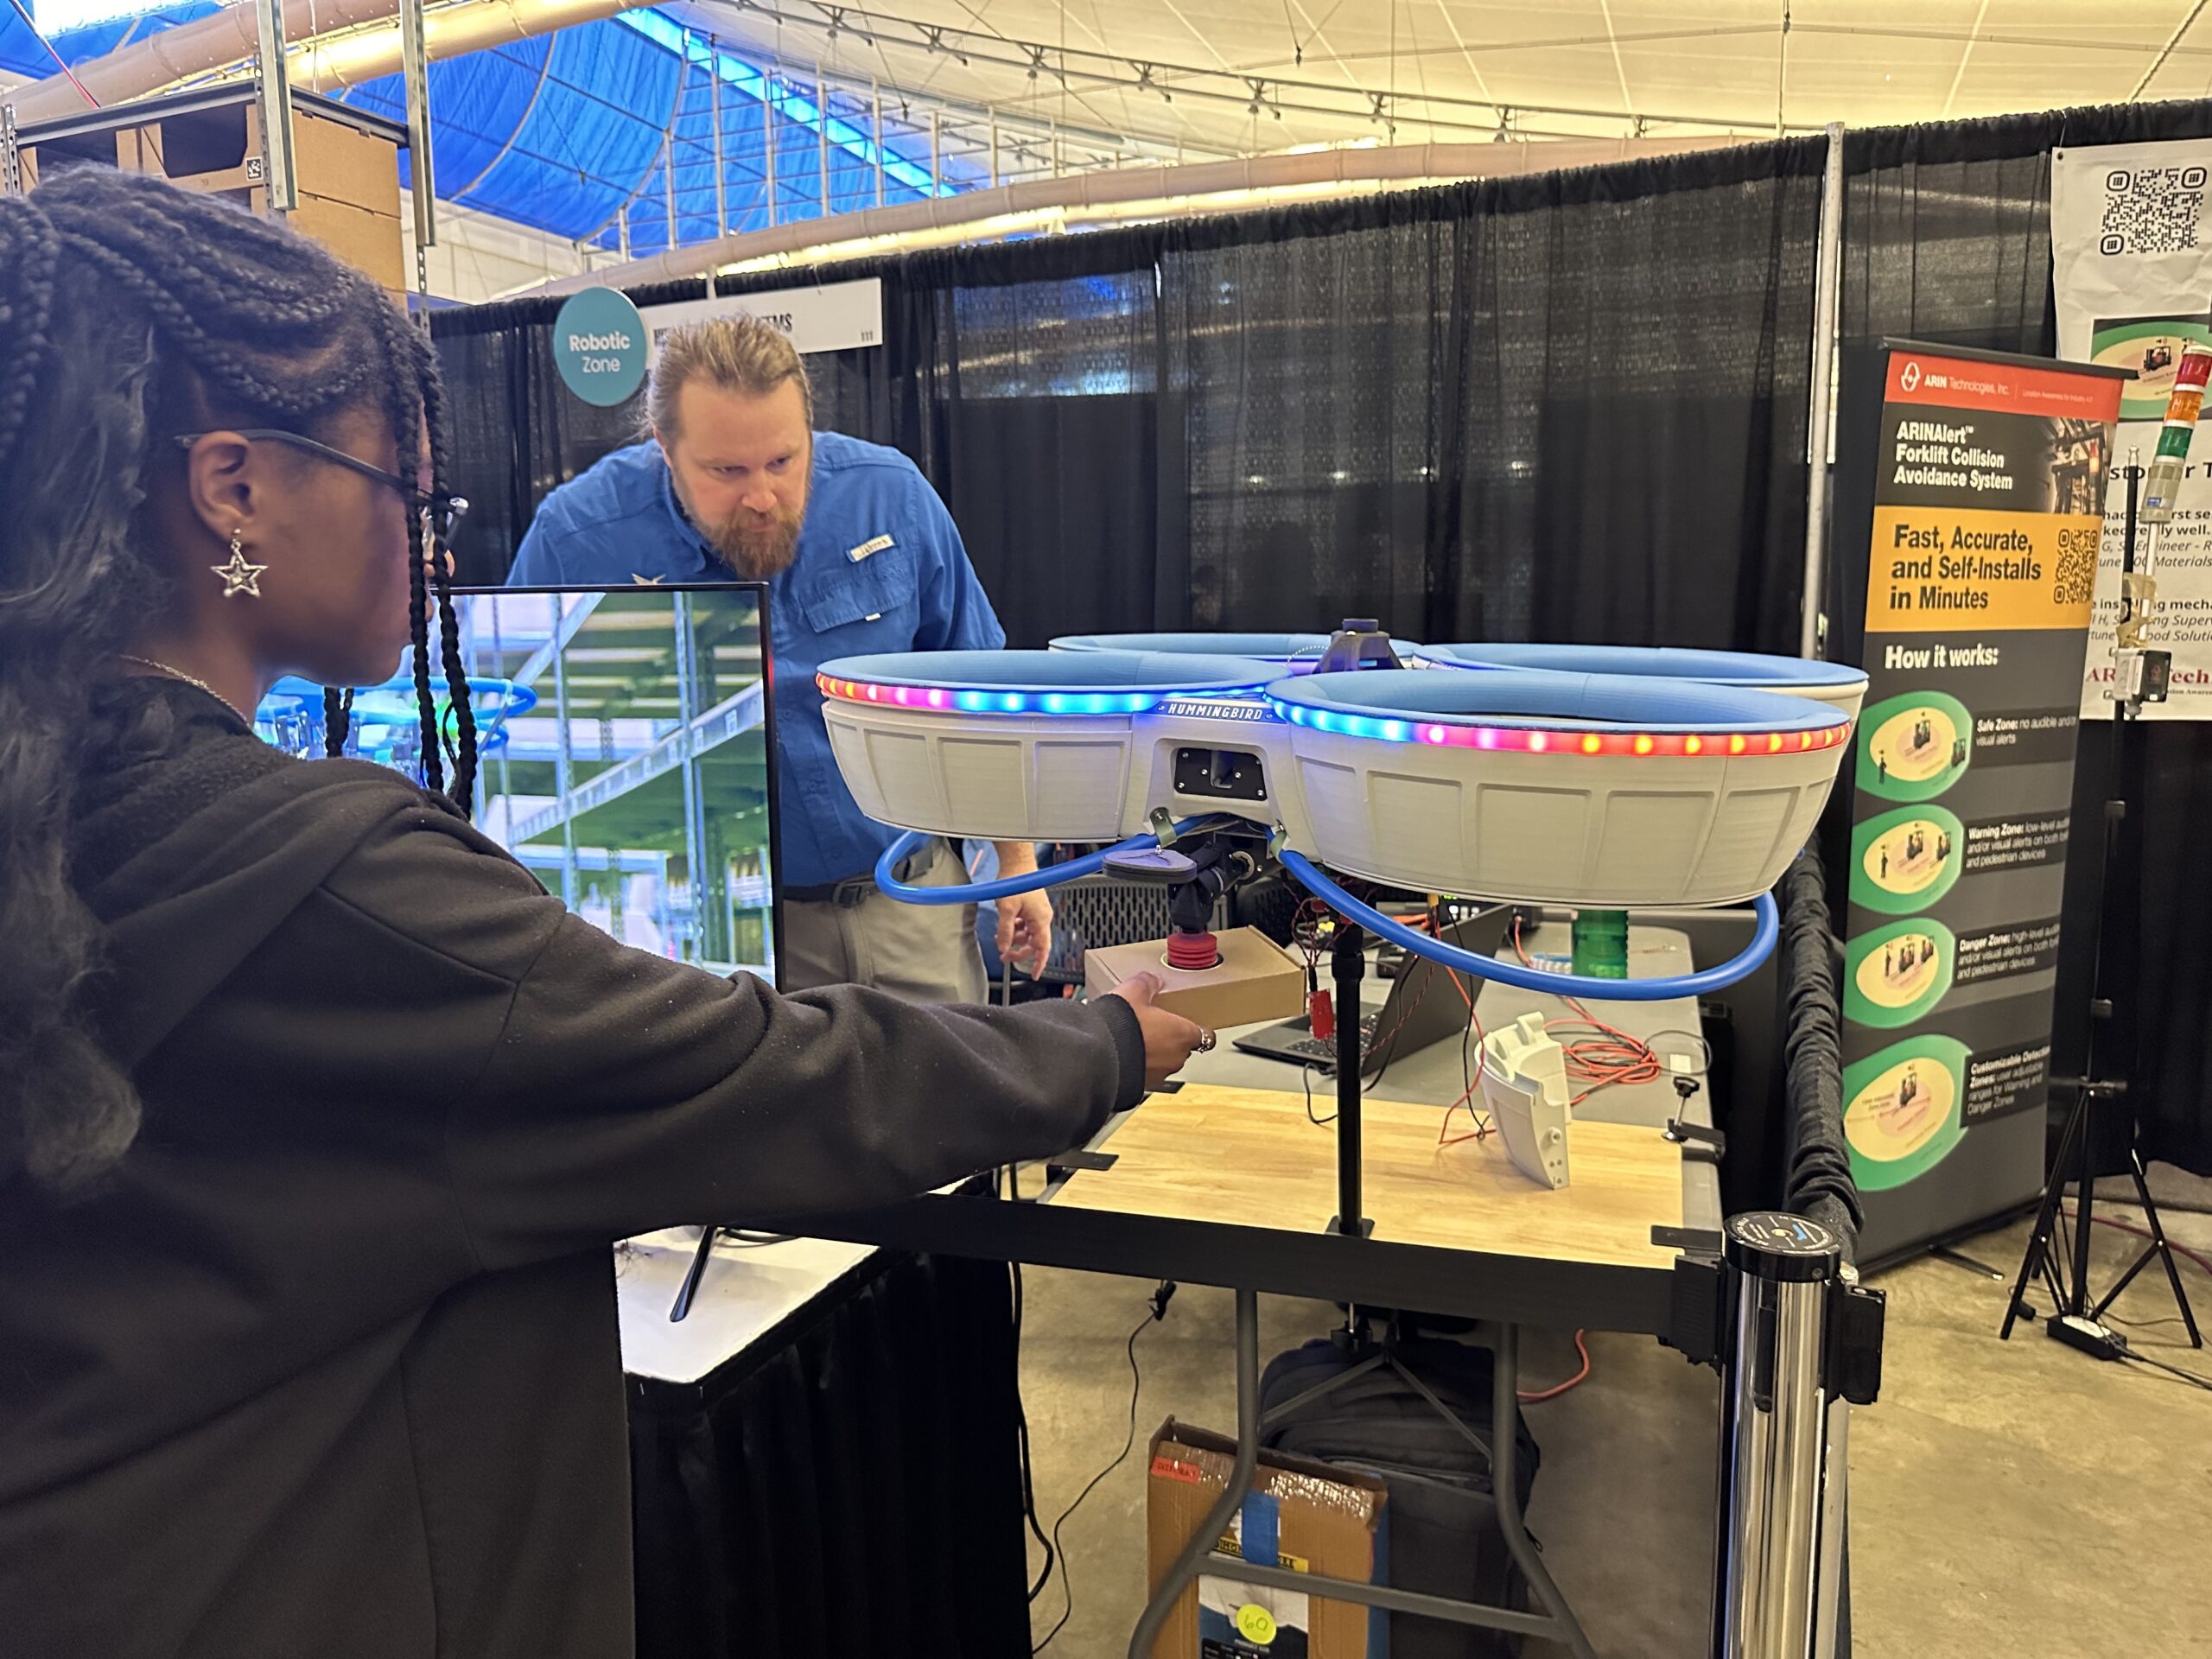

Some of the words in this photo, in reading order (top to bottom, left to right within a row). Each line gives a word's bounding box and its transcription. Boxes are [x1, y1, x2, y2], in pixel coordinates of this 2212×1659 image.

[569, 331, 631, 352] Robotic
[582, 357, 621, 373] Zone
[1924, 374, 1948, 389] ARIN
[1948, 377, 1995, 396] Technologies,
[1895, 443, 1948, 464] Forklift
[1951, 447, 2005, 468] Collision
[1893, 465, 1967, 487] Avoidance
[1969, 468, 2013, 491] System
[2202, 461, 2212, 479] T
[2177, 524, 2211, 536] well.
[1894, 524, 1944, 554] Fast,
[1951, 525, 2033, 556] Accurate,
[2203, 539, 2212, 552] R
[1891, 556, 1932, 579] and
[1938, 556, 2041, 580] Self-Installs
[1889, 586, 1911, 609] in
[1919, 586, 1989, 609] Minutes
[2170, 598, 2212, 610] mech
[2172, 614, 2212, 629] Super
[2089, 631, 2115, 641] tune
[2173, 630, 2212, 642] Soluti
[1885, 645, 1930, 670] How
[1933, 644, 1946, 667] it
[1949, 643, 1999, 666] works:
[1168, 702, 1262, 720] HUMMINGBIRD
[1977, 718, 1995, 733] Safe
[1996, 717, 2018, 731] Zone:
[2031, 715, 2057, 728] audible
[1996, 733, 2017, 745] alerts
[1968, 825, 2000, 840] Warning
[2001, 823, 2024, 836] Zone:
[2012, 836, 2032, 849] alerts
[2033, 836, 2044, 846] on
[1966, 855, 1980, 868] and
[1980, 851, 2018, 868] pedestrian
[2018, 848, 2046, 861] devices
[1960, 938, 1987, 952] Danger
[1988, 933, 2011, 947] Zone:
[1971, 1053, 2021, 1076] Customizable
[1969, 1074, 1996, 1089] Zones:
[1243, 1614, 1269, 1631] 60
